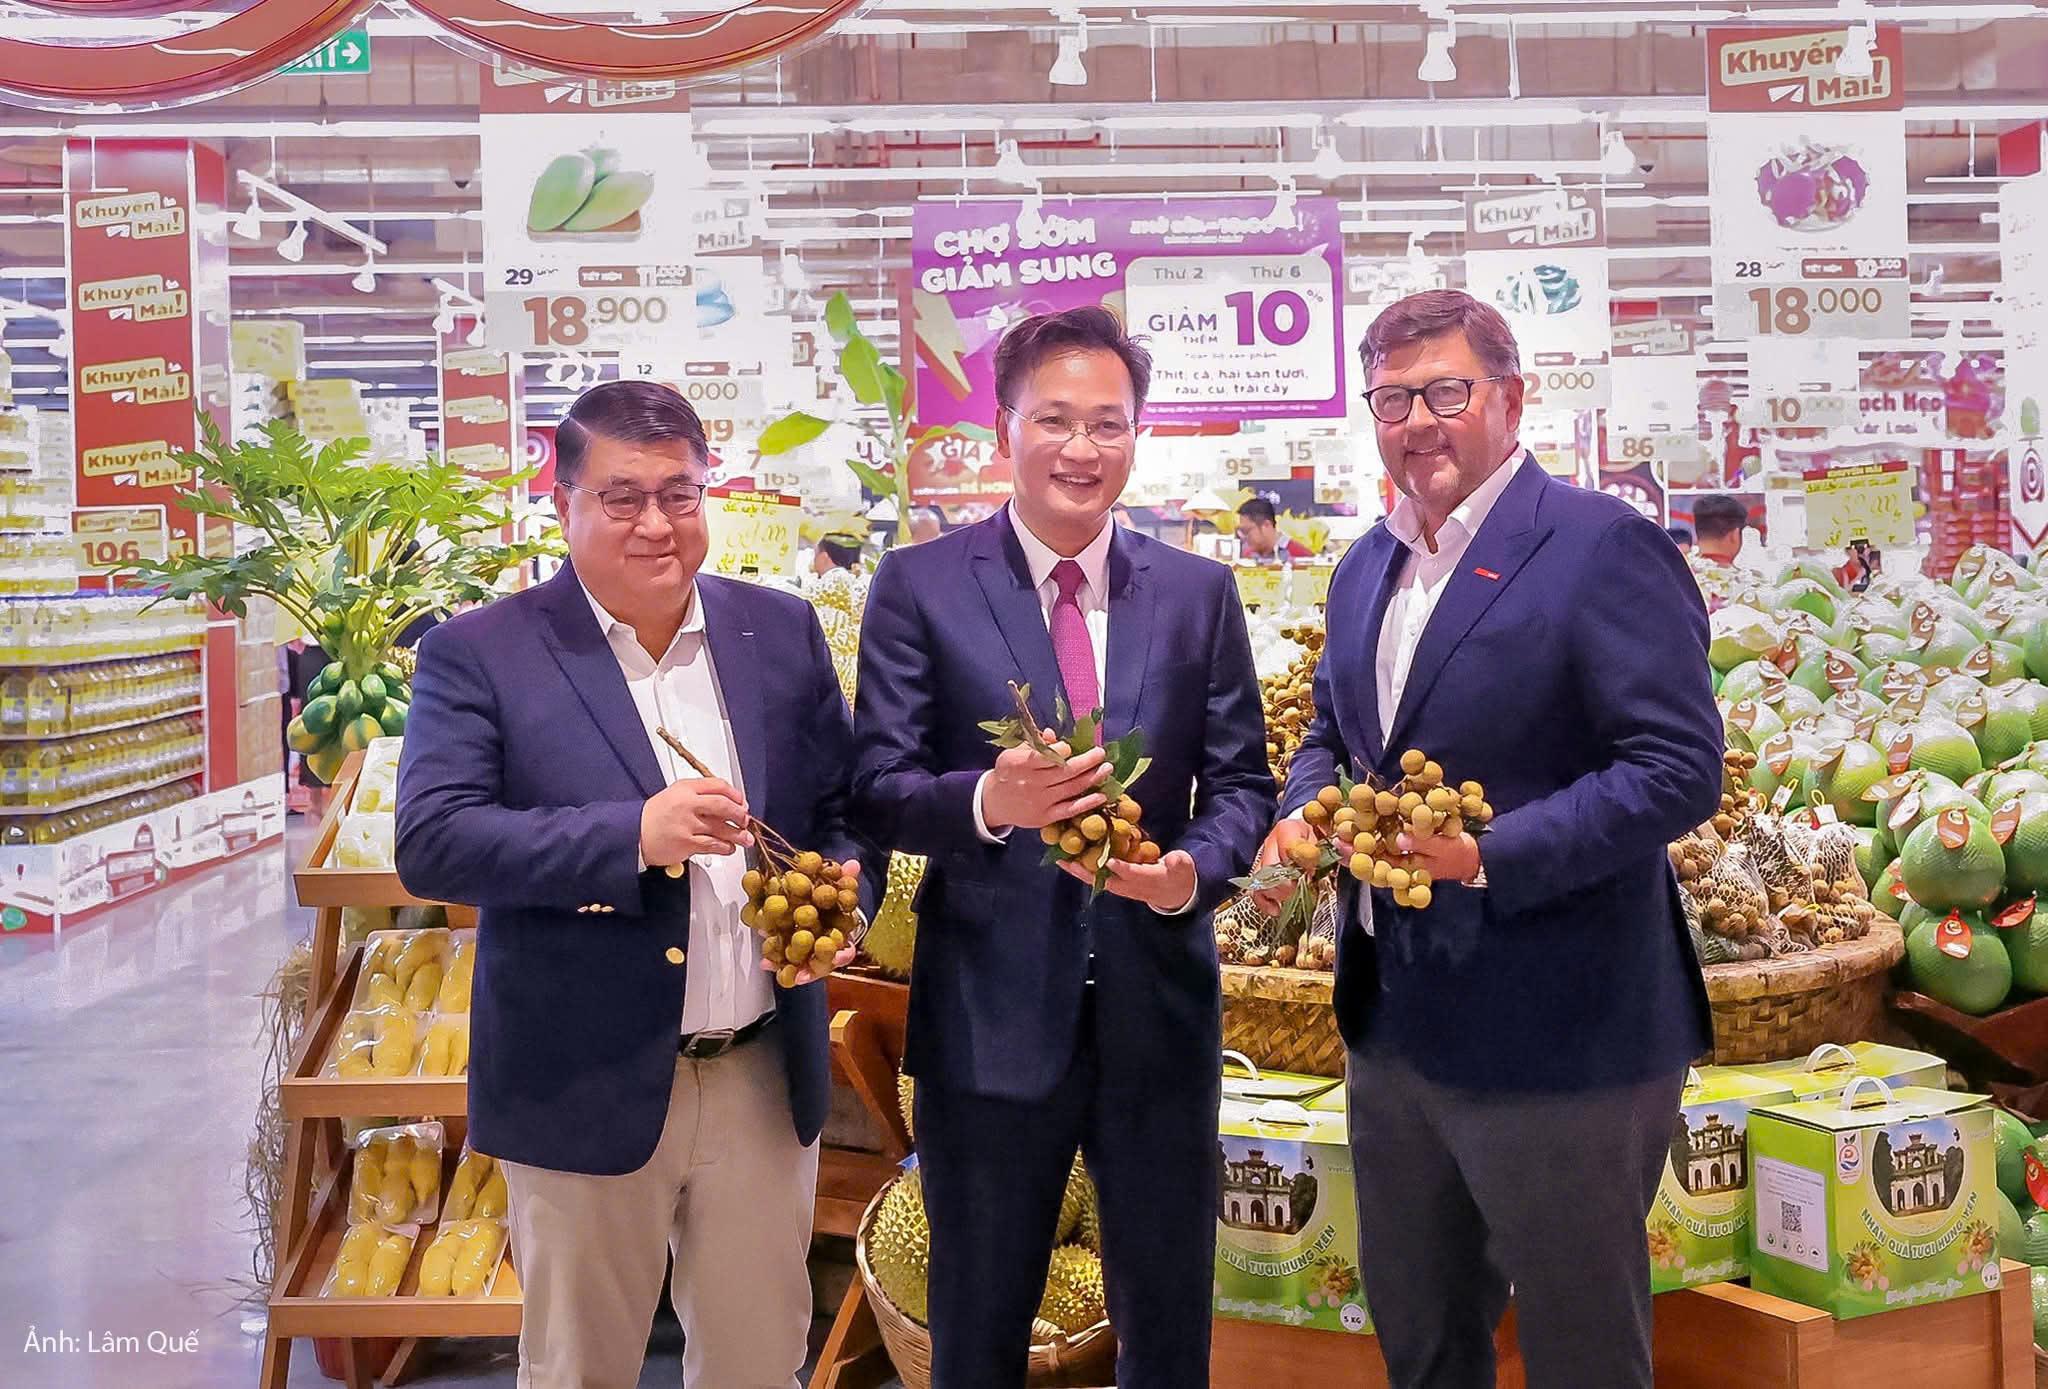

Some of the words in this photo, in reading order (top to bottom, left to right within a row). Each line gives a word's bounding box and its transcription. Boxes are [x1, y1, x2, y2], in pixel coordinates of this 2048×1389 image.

[933, 222, 1010, 257] CHỢ
[505, 268, 533, 285] 29
[921, 255, 1012, 293] GIẢM
[1193, 267, 1204, 280] 2
[1290, 265, 1301, 278] 6
[1735, 261, 1762, 278] 28
[1149, 306, 1217, 332] GIẢM
[1285, 440, 1312, 461] 15
[1622, 437, 1655, 458] 86
[1225, 458, 1253, 476] 95
[81, 541, 140, 564] 106
